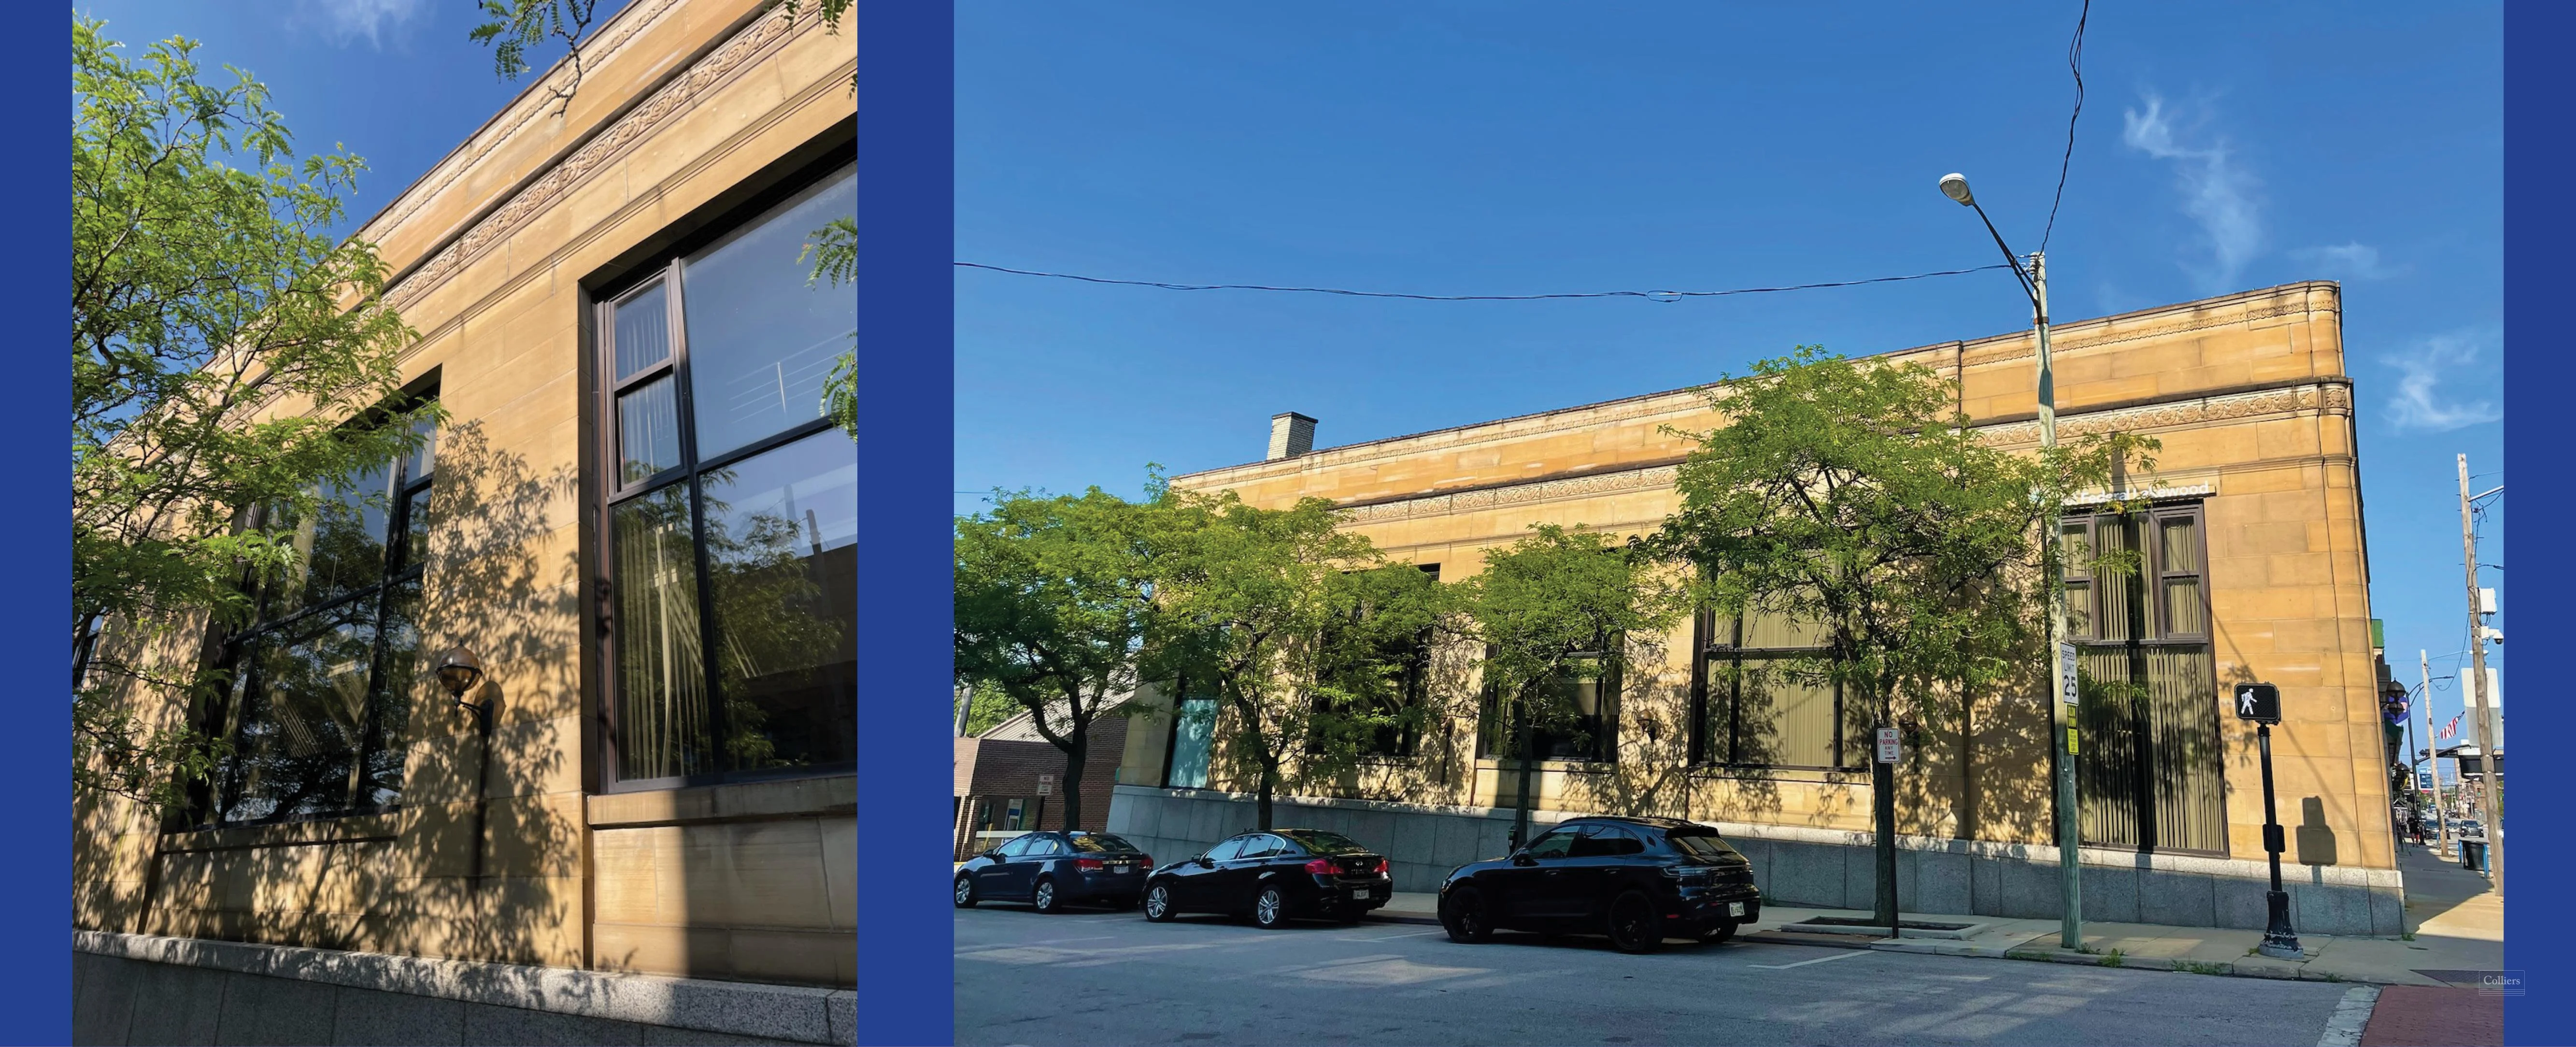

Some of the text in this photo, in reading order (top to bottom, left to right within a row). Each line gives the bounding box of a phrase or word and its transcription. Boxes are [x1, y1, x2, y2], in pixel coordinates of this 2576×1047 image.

[2081, 488, 2129, 503] Federal
[2133, 480, 2208, 500] Lakewood
[2062, 650, 2075, 661] SPEED
[2064, 675, 2077, 697] 25
